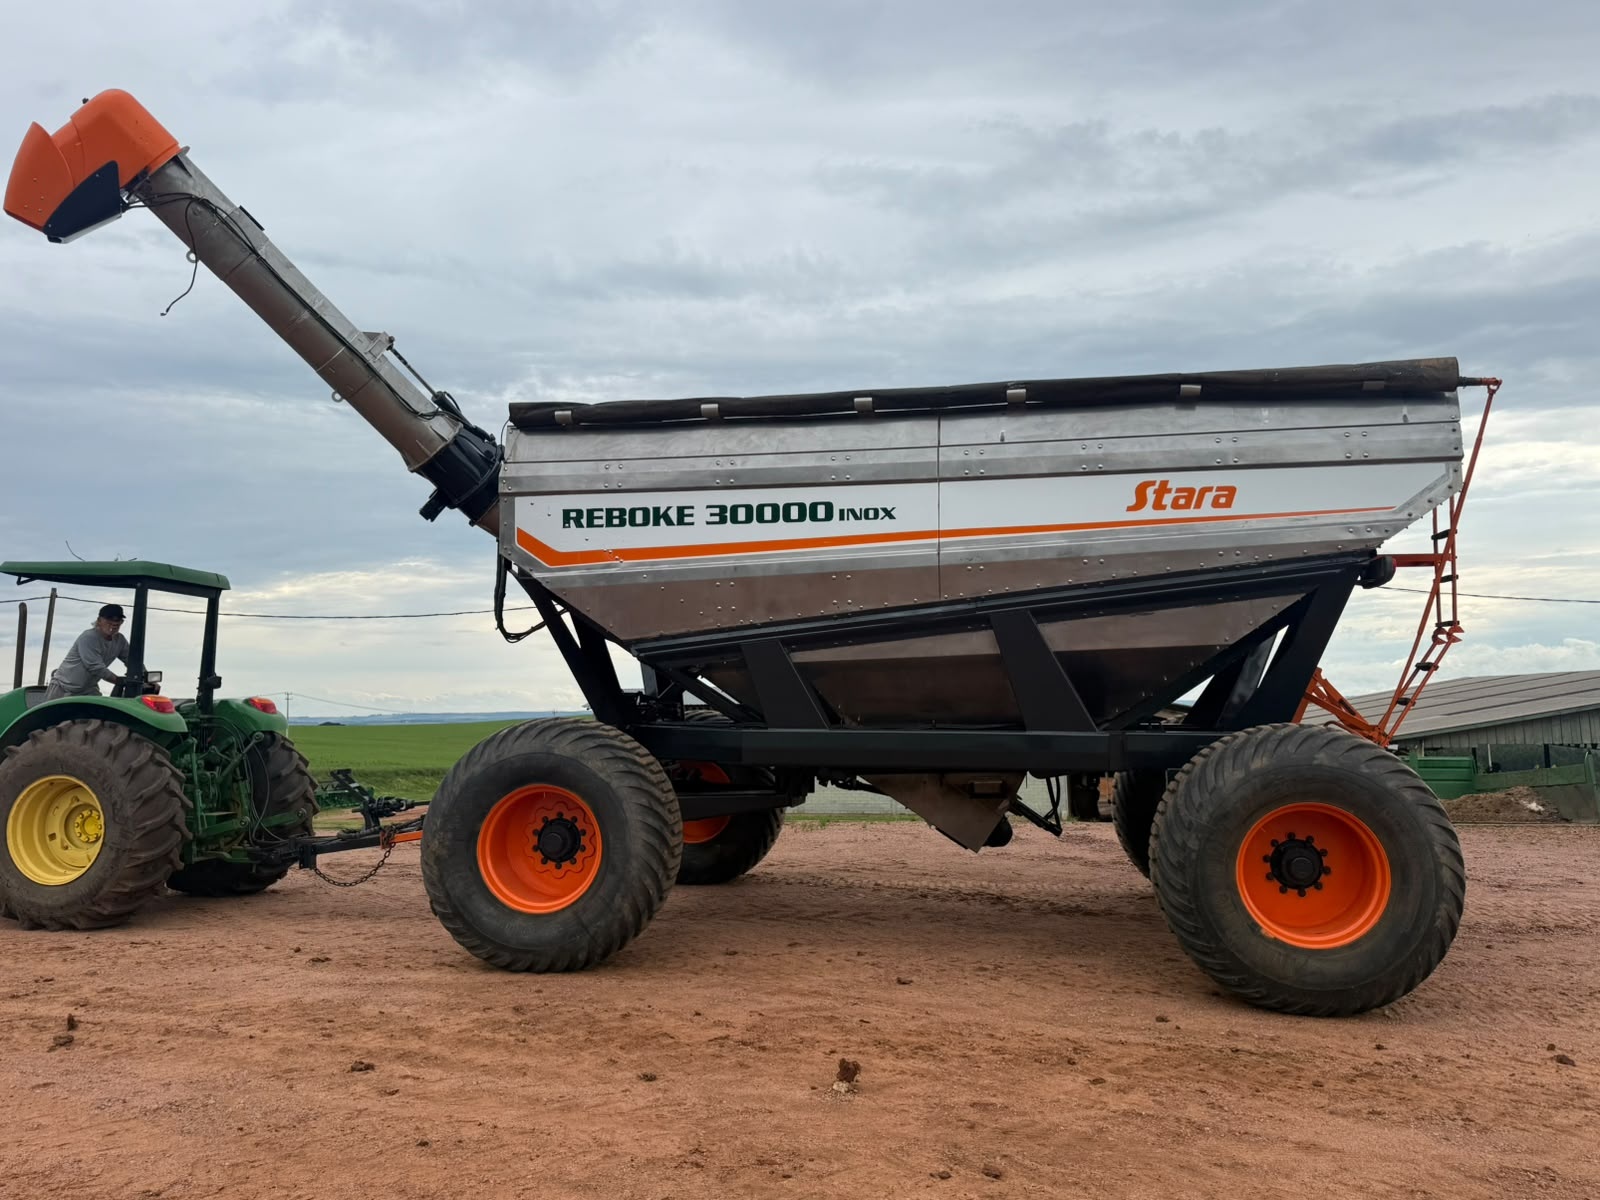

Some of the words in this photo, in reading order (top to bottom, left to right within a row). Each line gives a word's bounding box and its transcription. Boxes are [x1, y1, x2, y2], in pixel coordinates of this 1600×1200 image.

[1126, 480, 1237, 512] Stara
[562, 505, 695, 528] REBOKE
[705, 501, 834, 525] 30000
[838, 507, 896, 521] INOX
